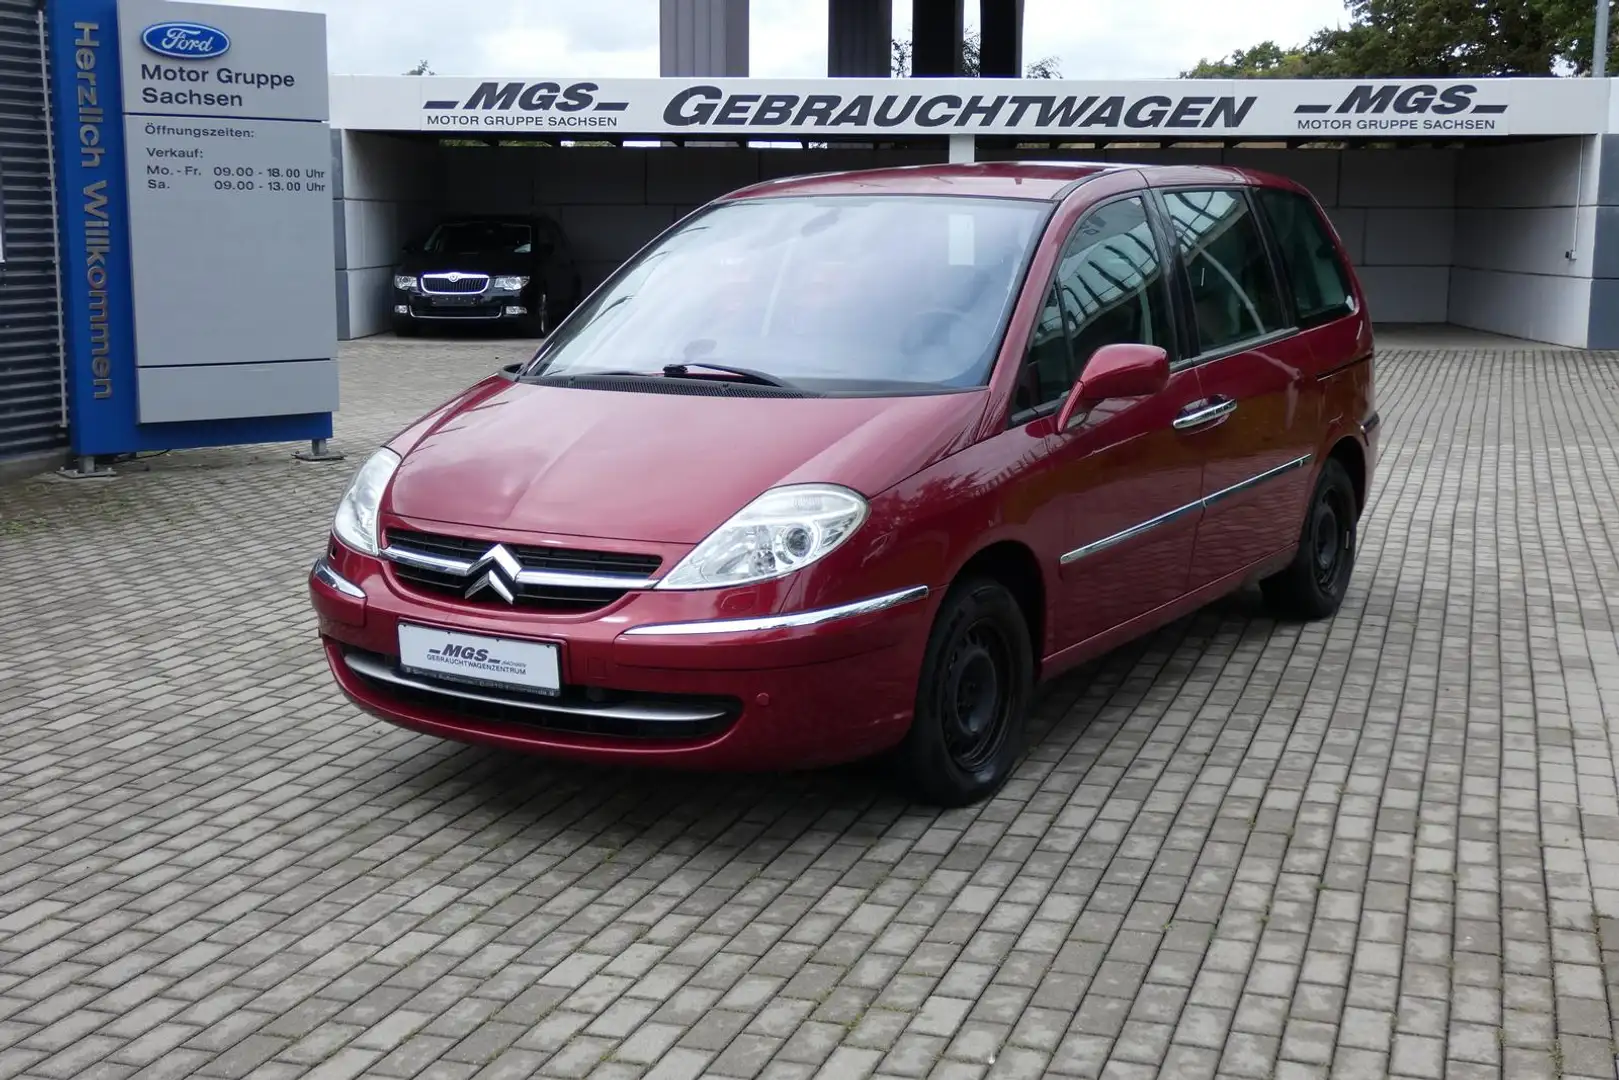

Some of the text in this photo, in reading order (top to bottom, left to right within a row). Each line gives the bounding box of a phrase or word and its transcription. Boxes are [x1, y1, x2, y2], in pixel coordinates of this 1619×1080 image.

[161, 27, 213, 52] Ford
[141, 64, 295, 89] Motor Gruppe
[142, 87, 243, 106] Sachsen
[662, 85, 1258, 128] GEBRAUCHTWAGEN
[144, 122, 255, 138] Öffnungszeiten:
[426, 115, 617, 127] MOTOR GRUPPE SACHSEN
[1297, 119, 1495, 130] MOTOR GRUPPE SACHSEN
[146, 147, 204, 159] Verkauf:
[146, 165, 174, 176] Mo.
[213, 167, 254, 177] 09.00
[267, 168, 300, 178] 18.00
[306, 169, 325, 179] Uhr
[147, 179, 170, 190] Sa.
[214, 181, 254, 190] 09.00
[268, 182, 301, 192] 13.00
[306, 183, 326, 192] Uhr
[73, 22, 113, 399] Herzlich Willkommen
[443, 644, 489, 662] MGS
[426, 653, 527, 675] GEBRAUCHTWAGENZENTRUM
